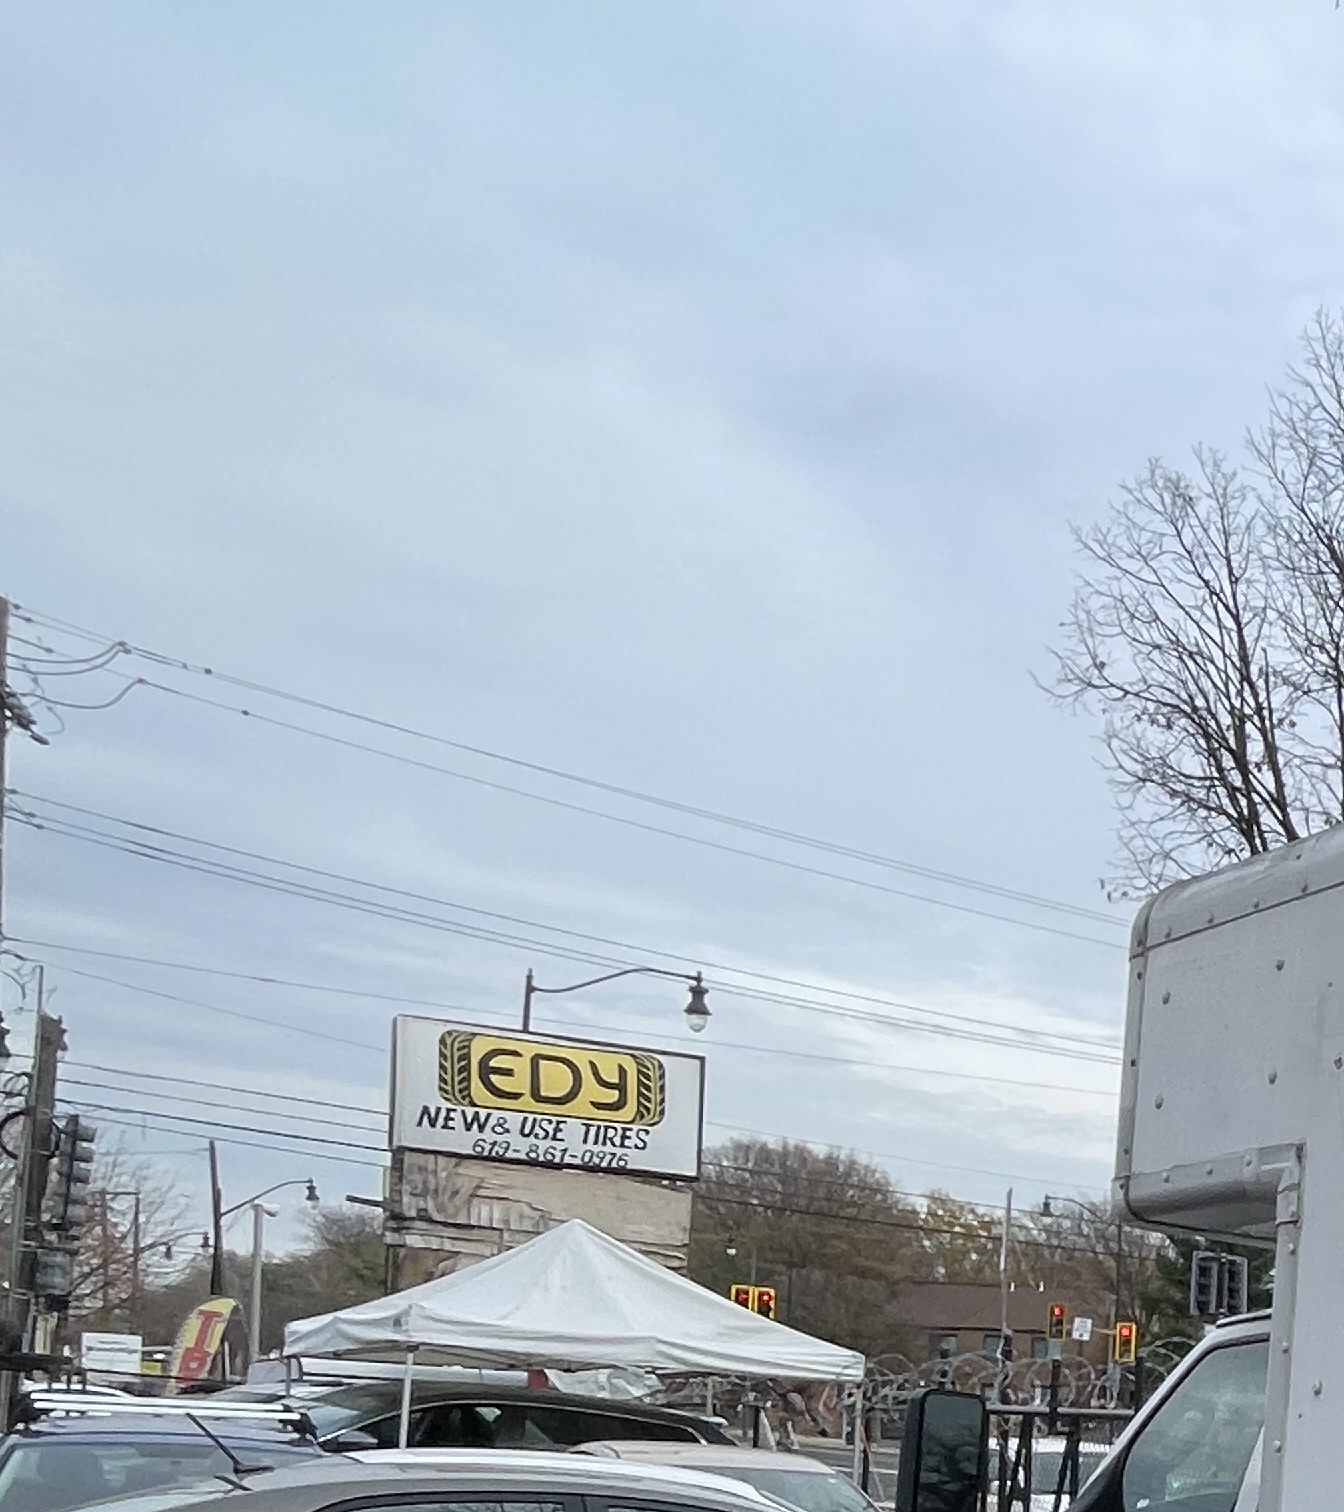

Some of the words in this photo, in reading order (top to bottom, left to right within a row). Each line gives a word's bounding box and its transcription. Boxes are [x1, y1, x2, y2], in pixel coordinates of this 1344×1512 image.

[478, 1048, 628, 1111] EDY
[519, 1116, 568, 1142] USE
[581, 1123, 650, 1150] TIRES
